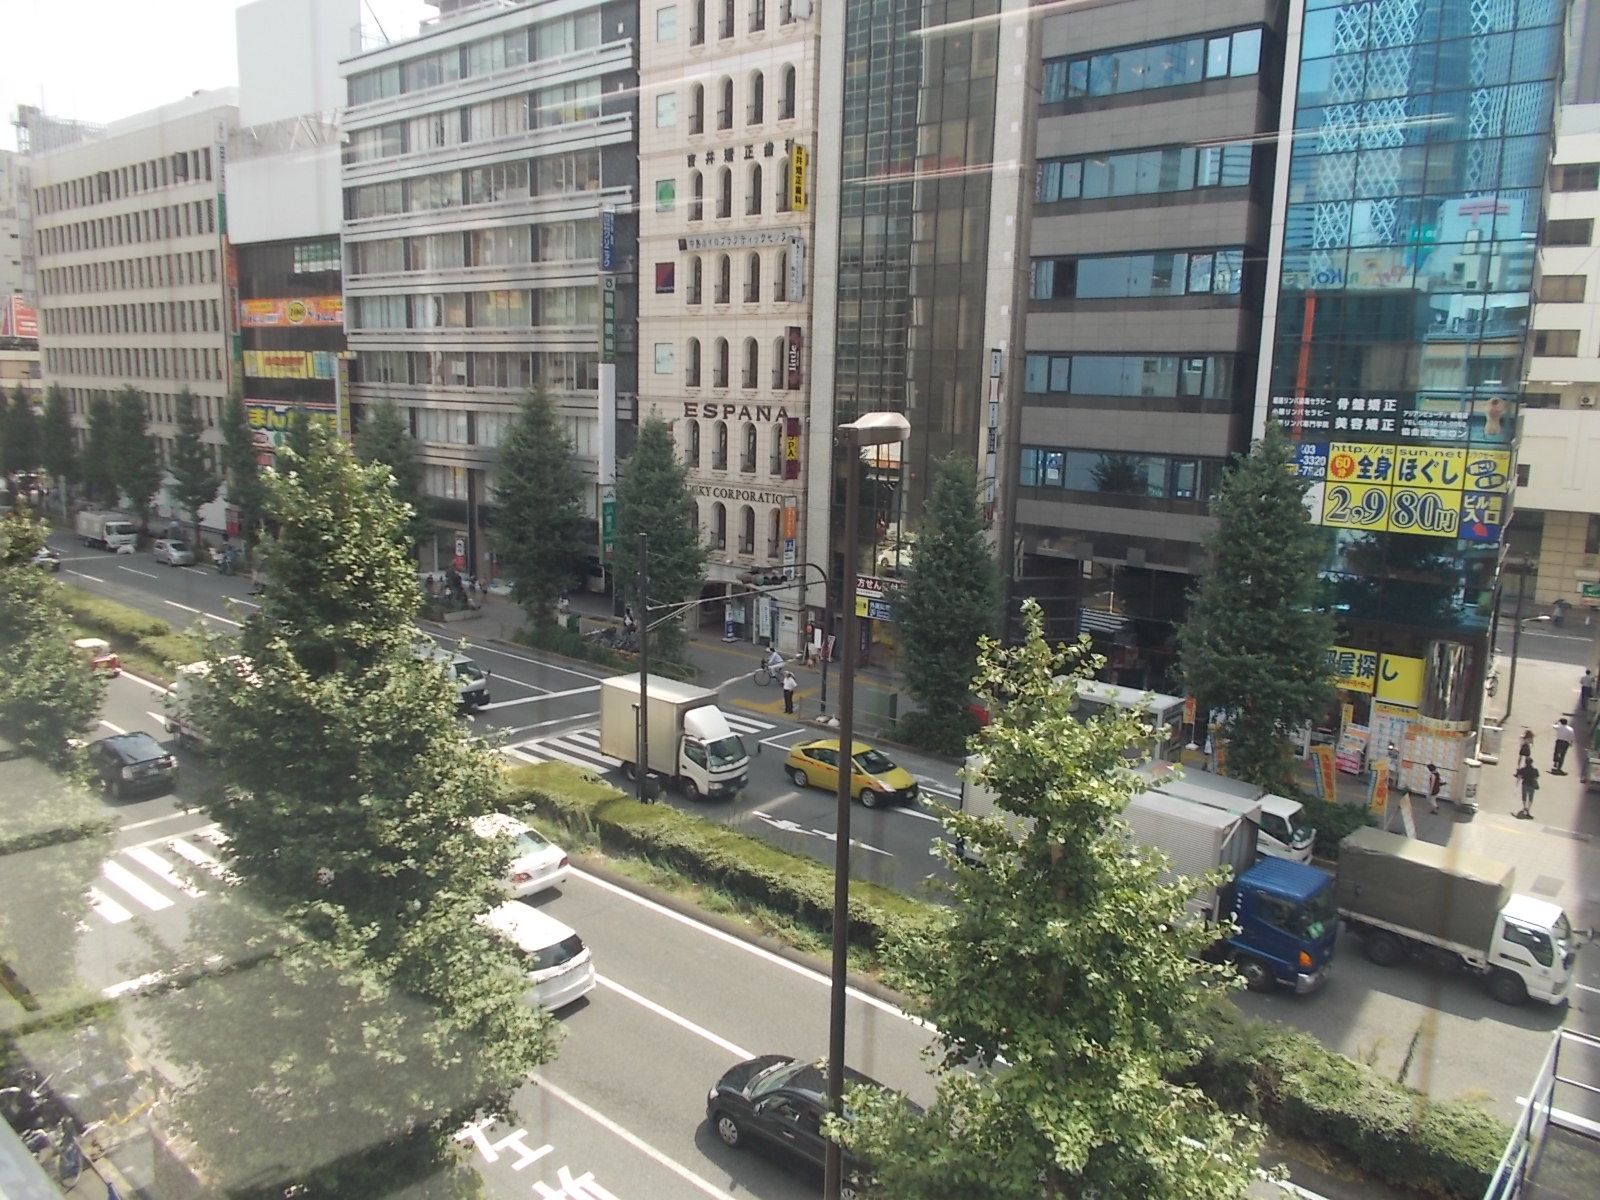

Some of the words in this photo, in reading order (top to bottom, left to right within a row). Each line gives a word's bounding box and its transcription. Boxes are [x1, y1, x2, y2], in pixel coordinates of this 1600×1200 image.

[684, 402, 789, 422] ESPANA
[1336, 397, 1398, 412] 骨盤矯正
[1334, 417, 1396, 431] 美容矯正
[713, 487, 783, 504] CORPORATIO
